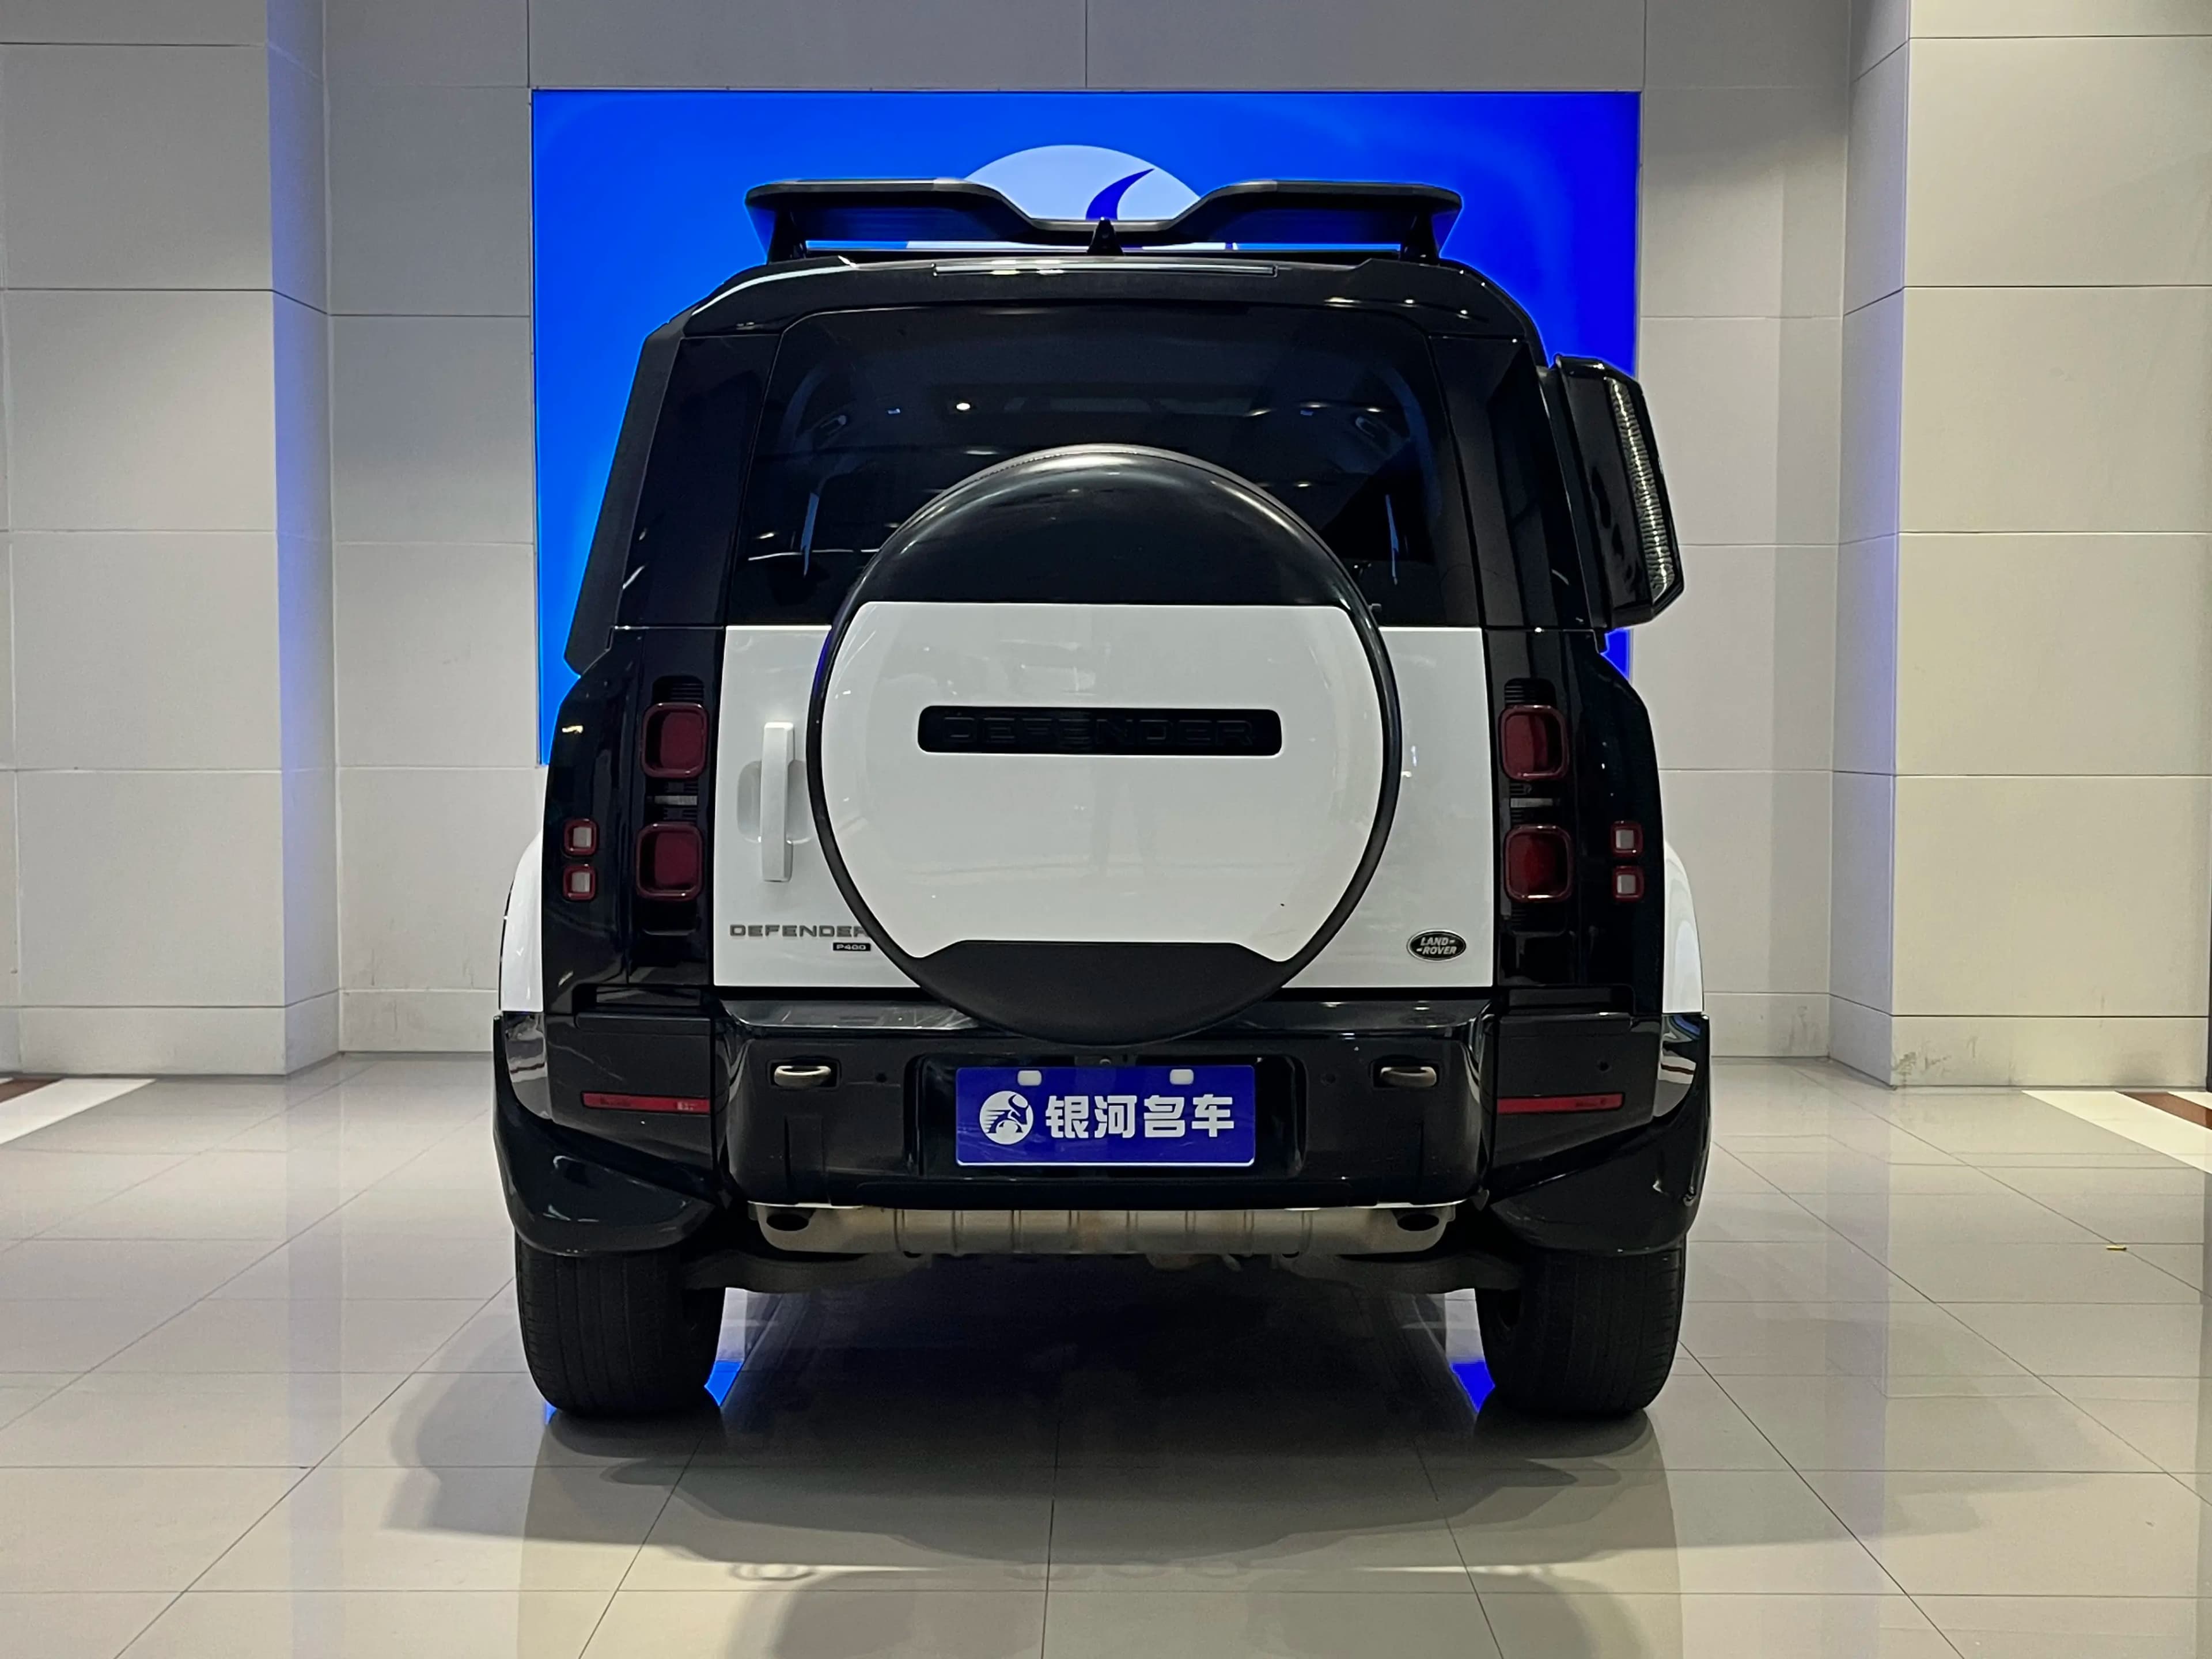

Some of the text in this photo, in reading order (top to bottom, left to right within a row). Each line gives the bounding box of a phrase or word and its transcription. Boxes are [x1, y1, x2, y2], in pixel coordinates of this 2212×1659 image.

[942, 715, 1254, 747] DEFENDER
[1045, 1093, 1235, 1139] 银河名车
